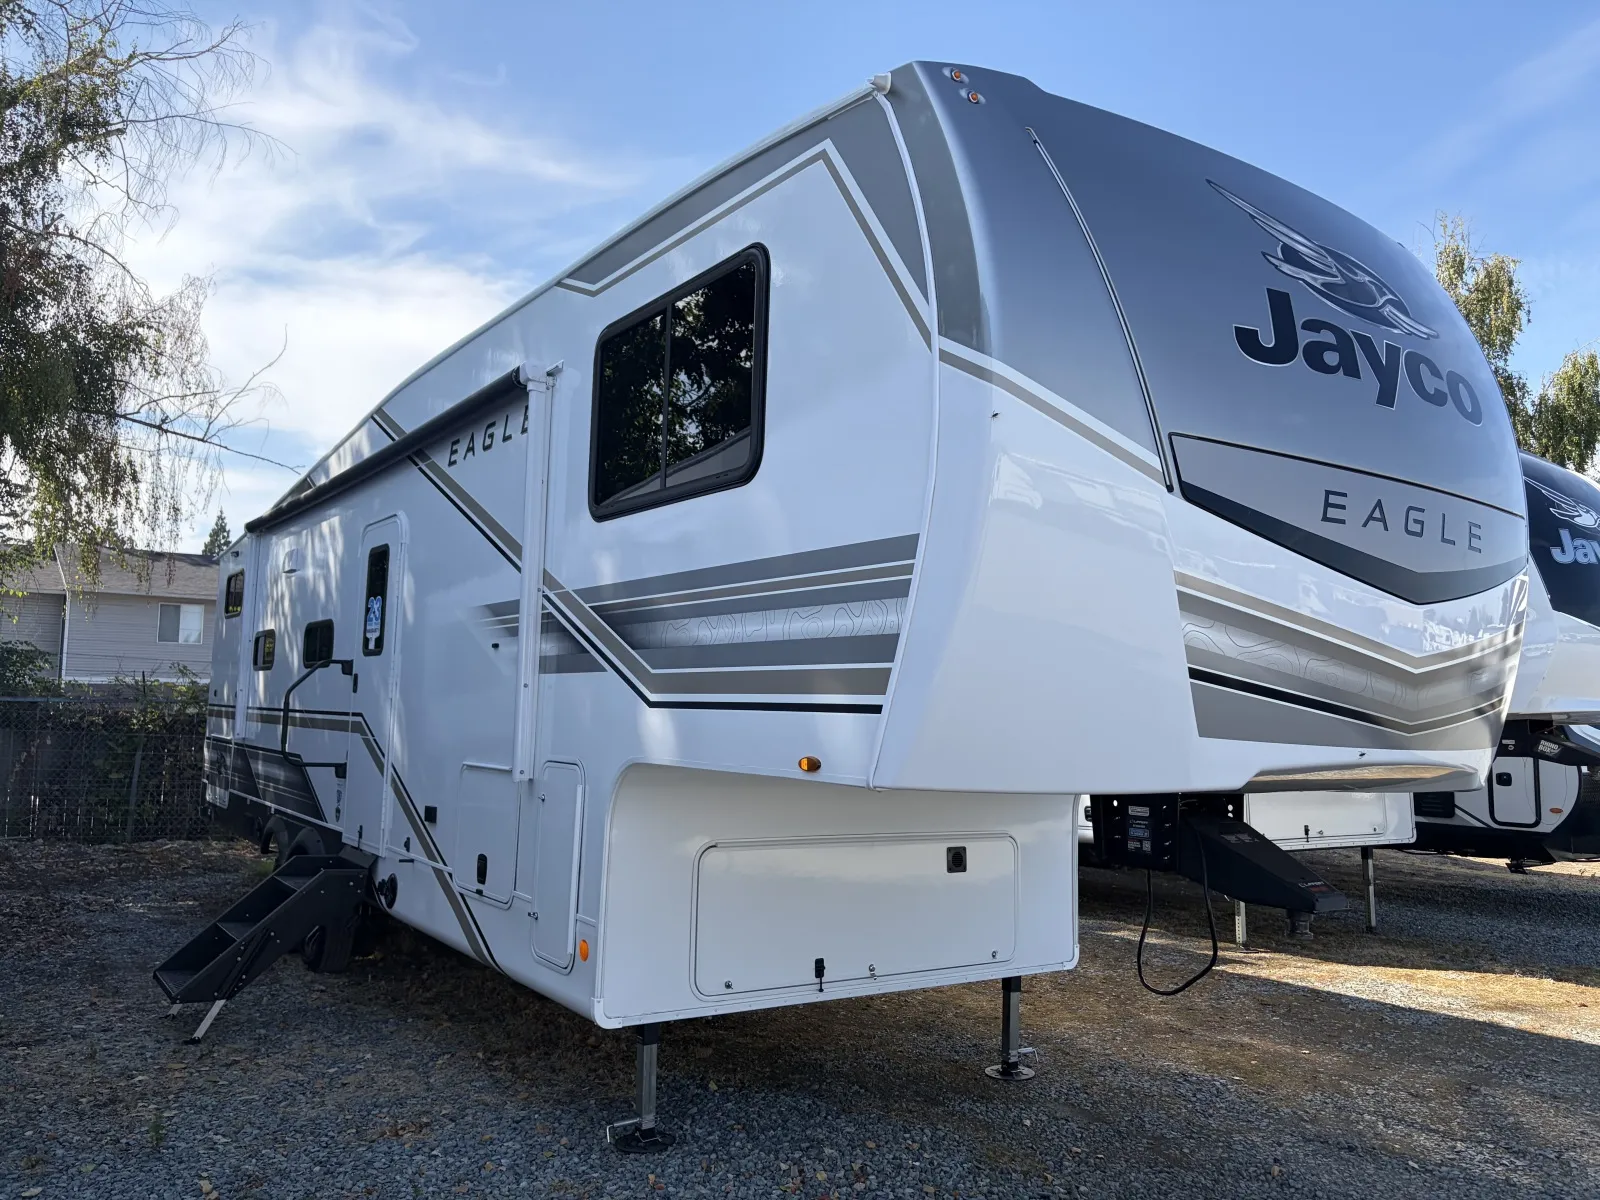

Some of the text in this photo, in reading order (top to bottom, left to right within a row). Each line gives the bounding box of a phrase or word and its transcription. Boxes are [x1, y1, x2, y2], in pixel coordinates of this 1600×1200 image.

[1232, 287, 1484, 427] Jayco
[1321, 489, 1483, 554] EAGLE
[1538, 744, 1552, 753] BOX
[1540, 739, 1559, 750] RHINO
